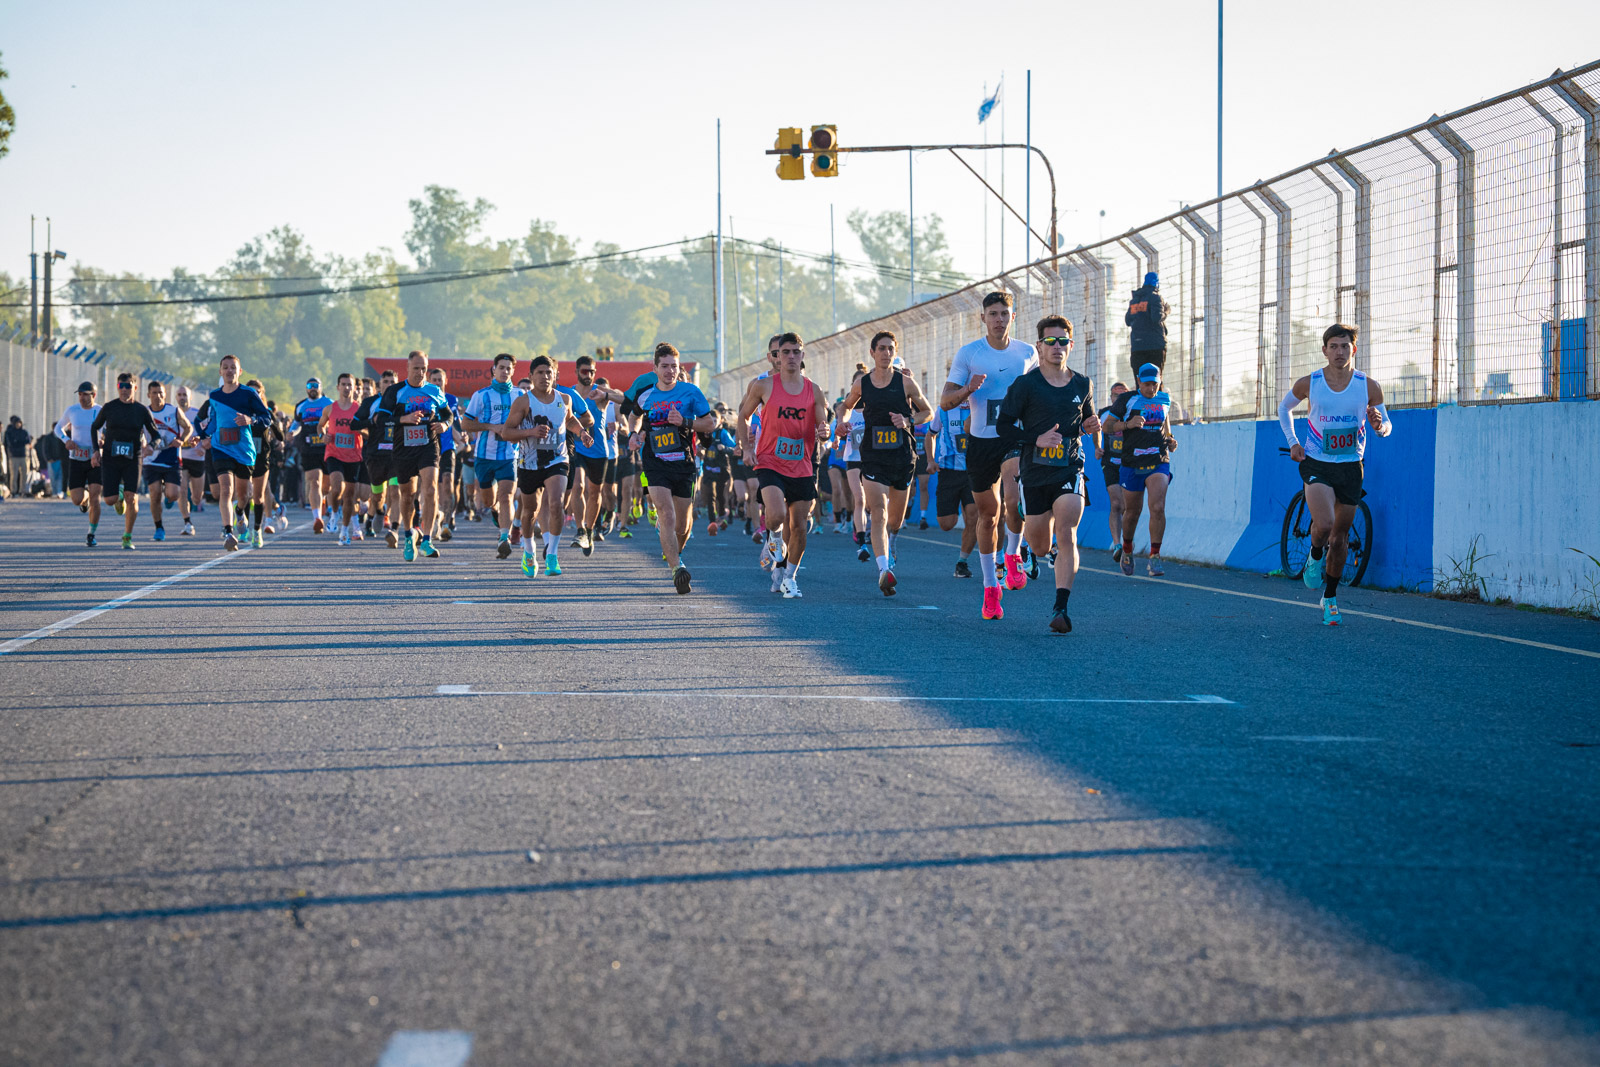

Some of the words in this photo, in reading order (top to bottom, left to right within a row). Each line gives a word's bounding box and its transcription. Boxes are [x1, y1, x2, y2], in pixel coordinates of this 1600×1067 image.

[778, 406, 807, 420] KRC
[408, 429, 424, 440] 359
[654, 431, 676, 448] 707
[876, 430, 897, 443] 718
[1330, 434, 1353, 449] 303
[115, 445, 131, 455] 167
[780, 442, 801, 456] 313
[1040, 444, 1065, 459] 706
